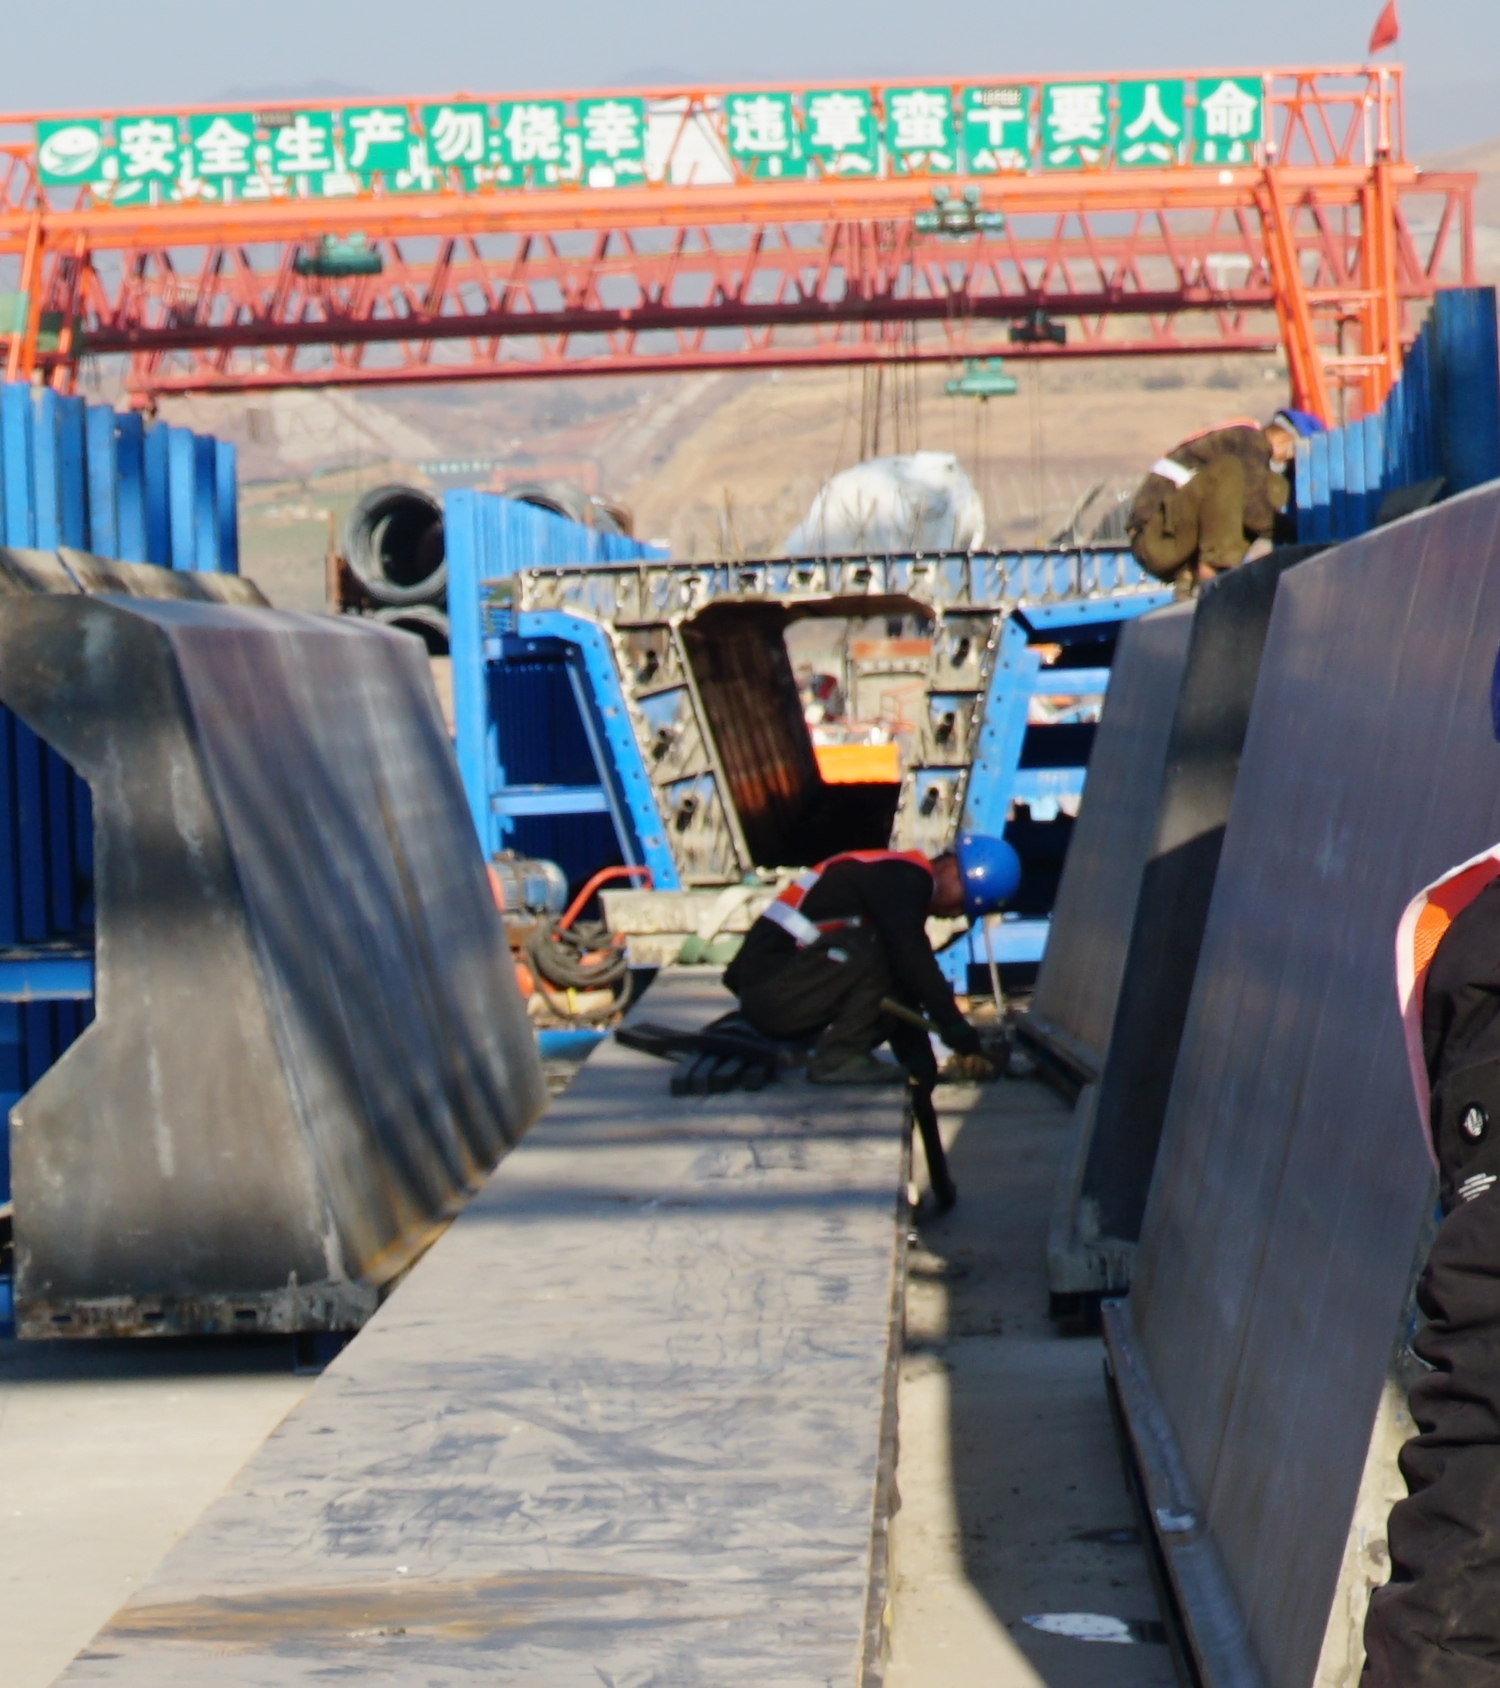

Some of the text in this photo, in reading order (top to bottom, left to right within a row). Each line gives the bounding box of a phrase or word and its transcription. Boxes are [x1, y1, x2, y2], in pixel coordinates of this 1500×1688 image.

[729, 79, 1260, 153] 违章蛮干要人命
